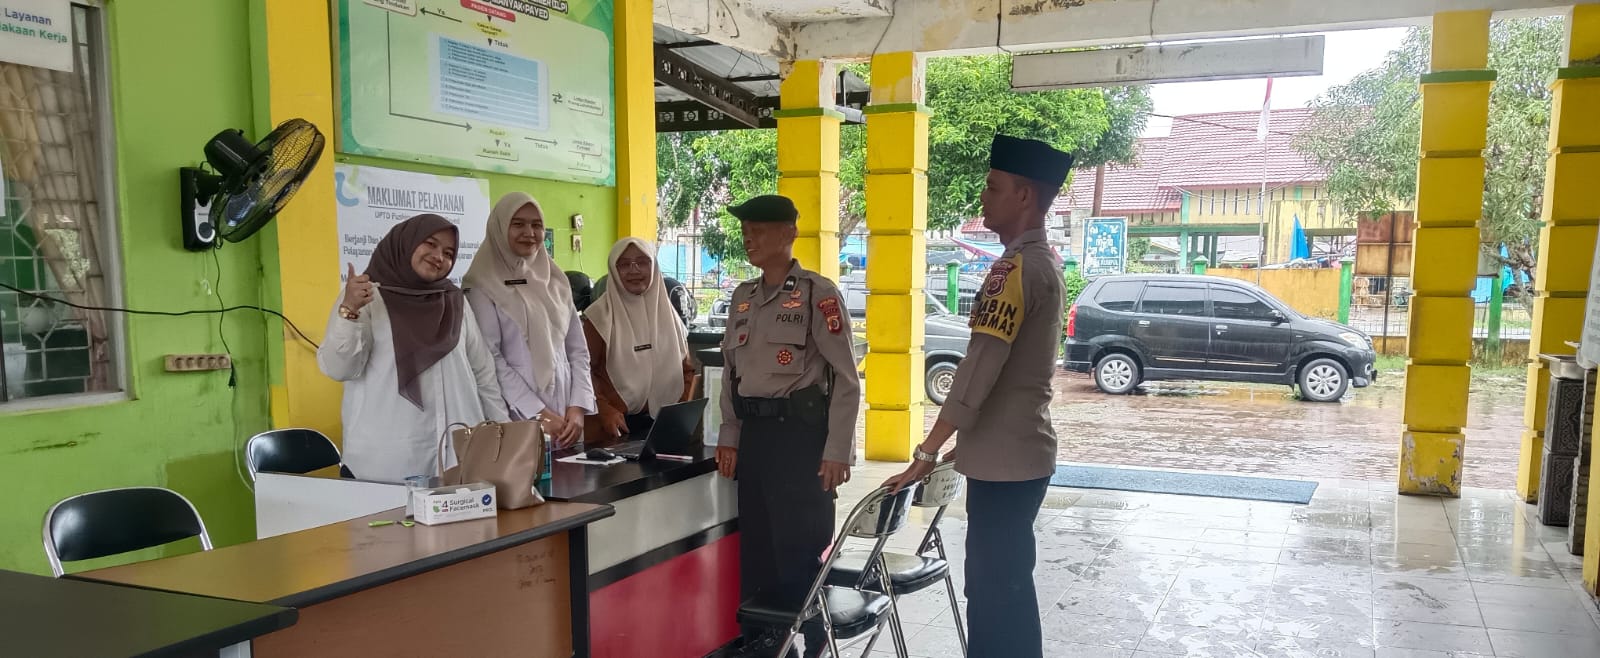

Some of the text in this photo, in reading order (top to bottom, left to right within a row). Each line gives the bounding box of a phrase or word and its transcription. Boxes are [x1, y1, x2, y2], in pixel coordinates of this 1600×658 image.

[5, 8, 52, 26] Layanan
[525, 4, 548, 19] PAYED
[0, 22, 68, 43] akaan Kerja
[367, 186, 465, 212] MAKLUMAT PELAYANAN
[775, 313, 804, 324] POLRI
[449, 498, 475, 506] Surgical
[449, 503, 479, 512] Facemask
